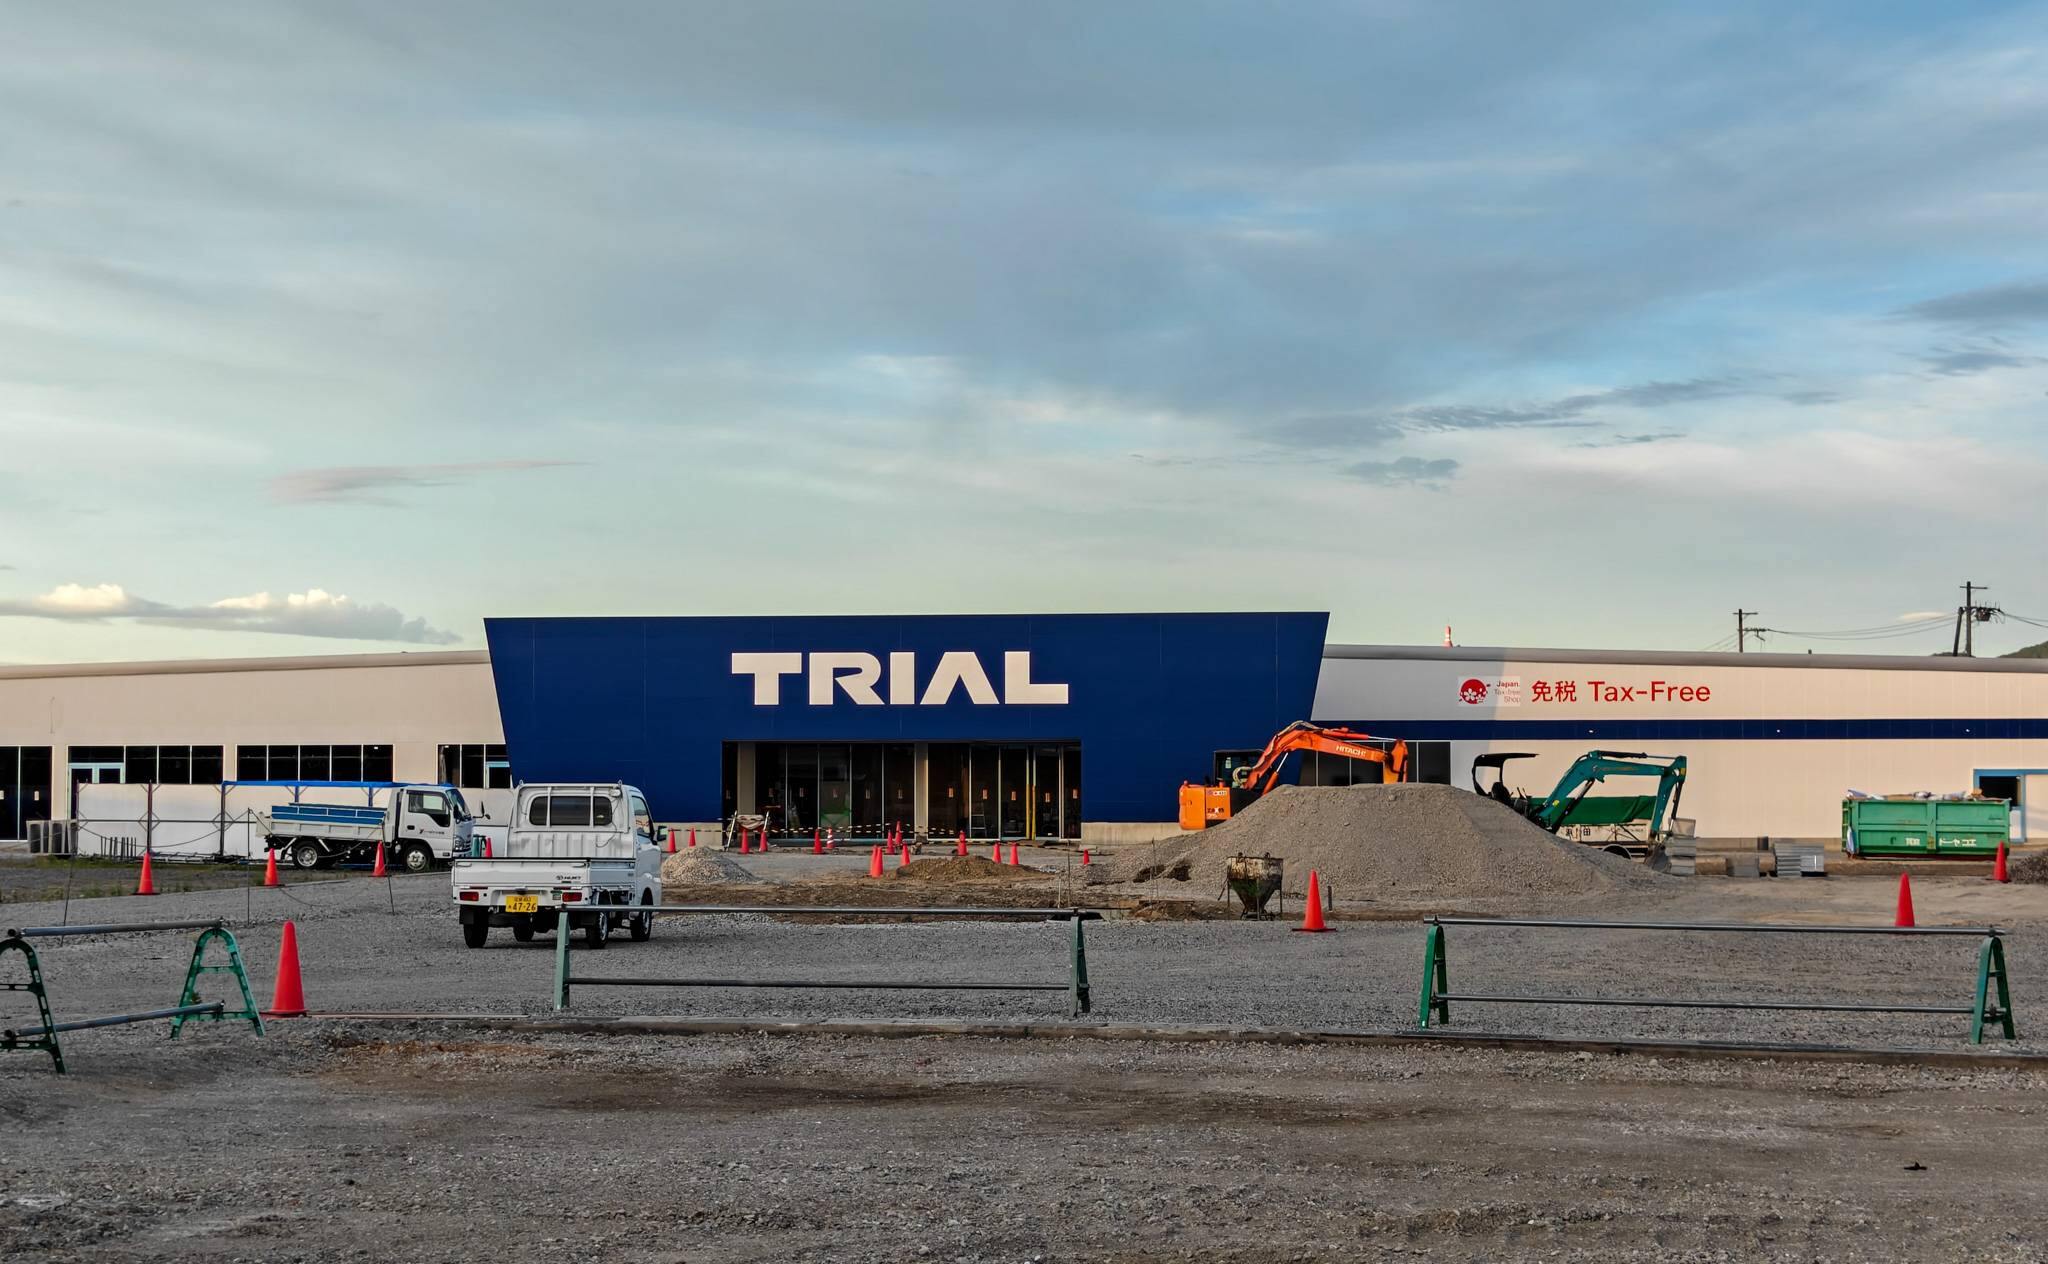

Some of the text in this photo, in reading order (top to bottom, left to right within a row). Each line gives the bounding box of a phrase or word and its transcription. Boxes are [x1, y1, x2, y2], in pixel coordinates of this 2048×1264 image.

[731, 651, 1069, 705] TRIAL
[1531, 680, 1711, 703] 免税 Tax-Free
